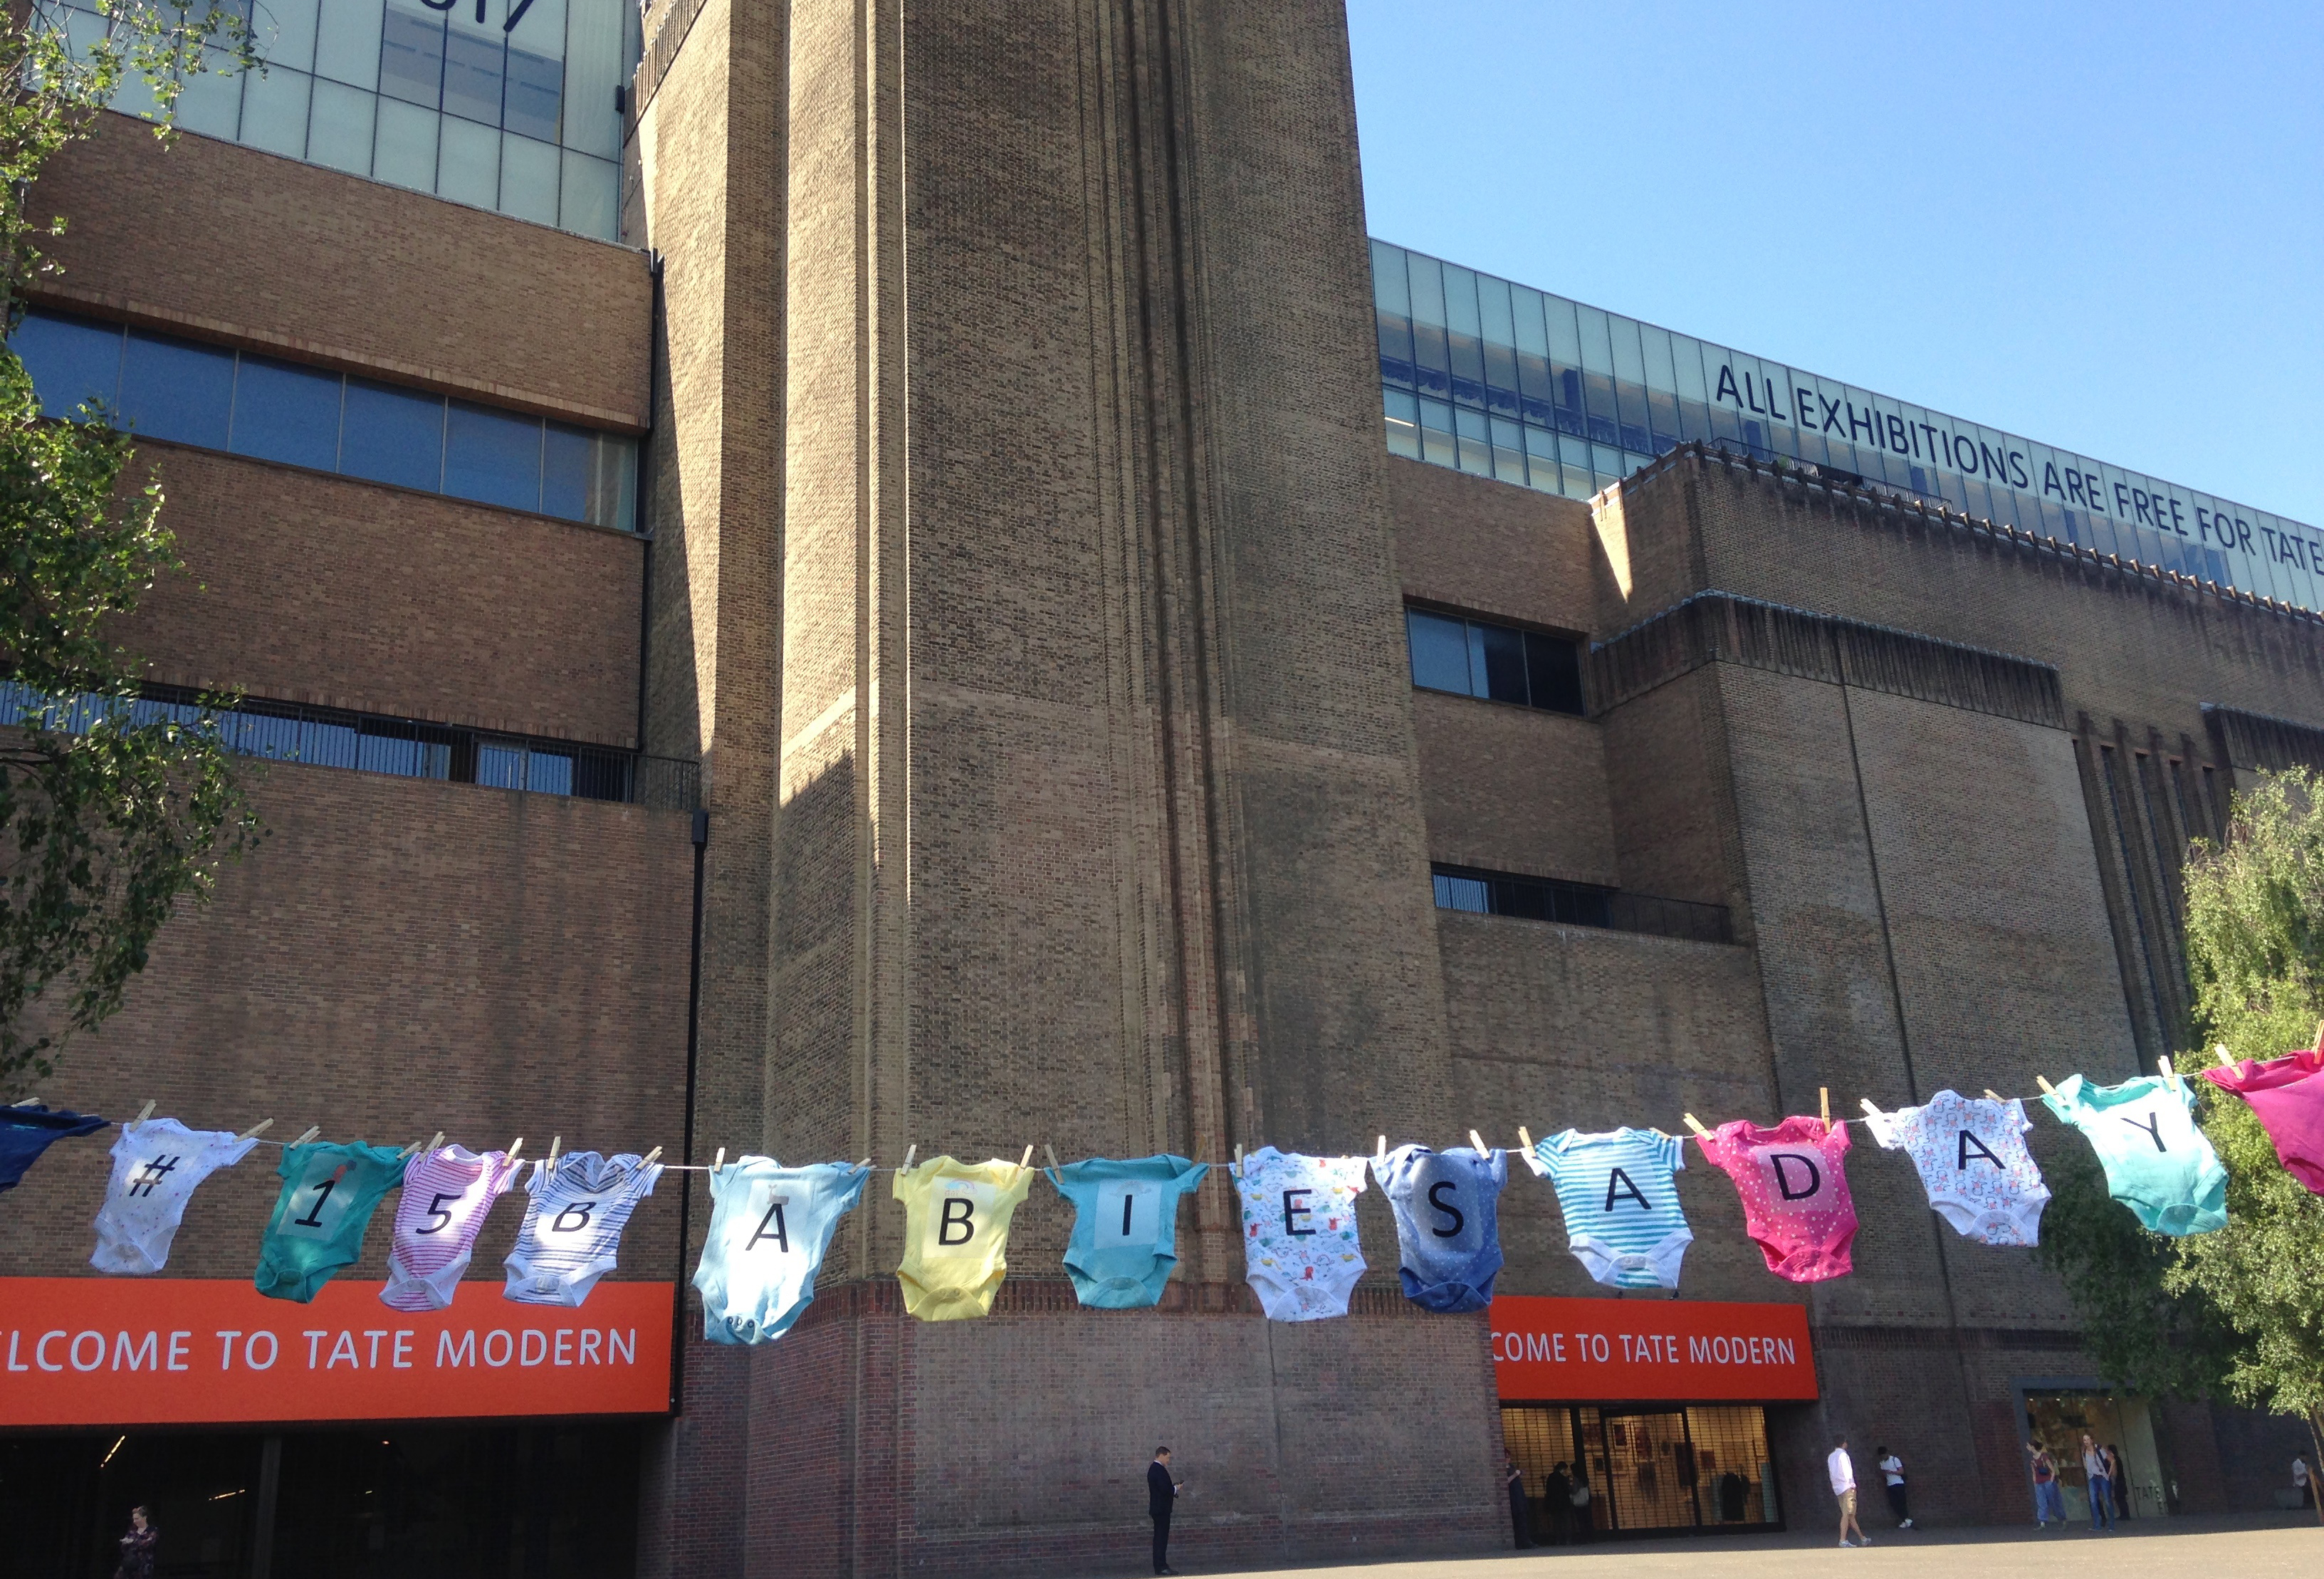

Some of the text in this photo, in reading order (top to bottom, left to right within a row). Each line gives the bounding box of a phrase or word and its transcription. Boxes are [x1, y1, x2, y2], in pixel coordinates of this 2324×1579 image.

[1717, 364, 2324, 575] ALL EXHIBITIONS ARE FREE FOR TATE
[295, 1179, 335, 1228] 1
[415, 1193, 461, 1234] 5
[551, 1201, 592, 1233] B
[745, 1203, 788, 1253] A
[938, 1197, 975, 1246] B
[1122, 1194, 1134, 1237] I
[1283, 1189, 1317, 1236] E
[1427, 1180, 1465, 1239] S
[1605, 1168, 1652, 1212] A
[1770, 1153, 1821, 1201] D
[1958, 1129, 2006, 1170] A
[2120, 1111, 2168, 1153] Y
[0, 1328, 636, 1371] LCOME TO TATE MODERN
[1576, 1333, 1609, 1363] TO
[1618, 1334, 1680, 1363] TATE
[1690, 1336, 1795, 1365] MODERN
